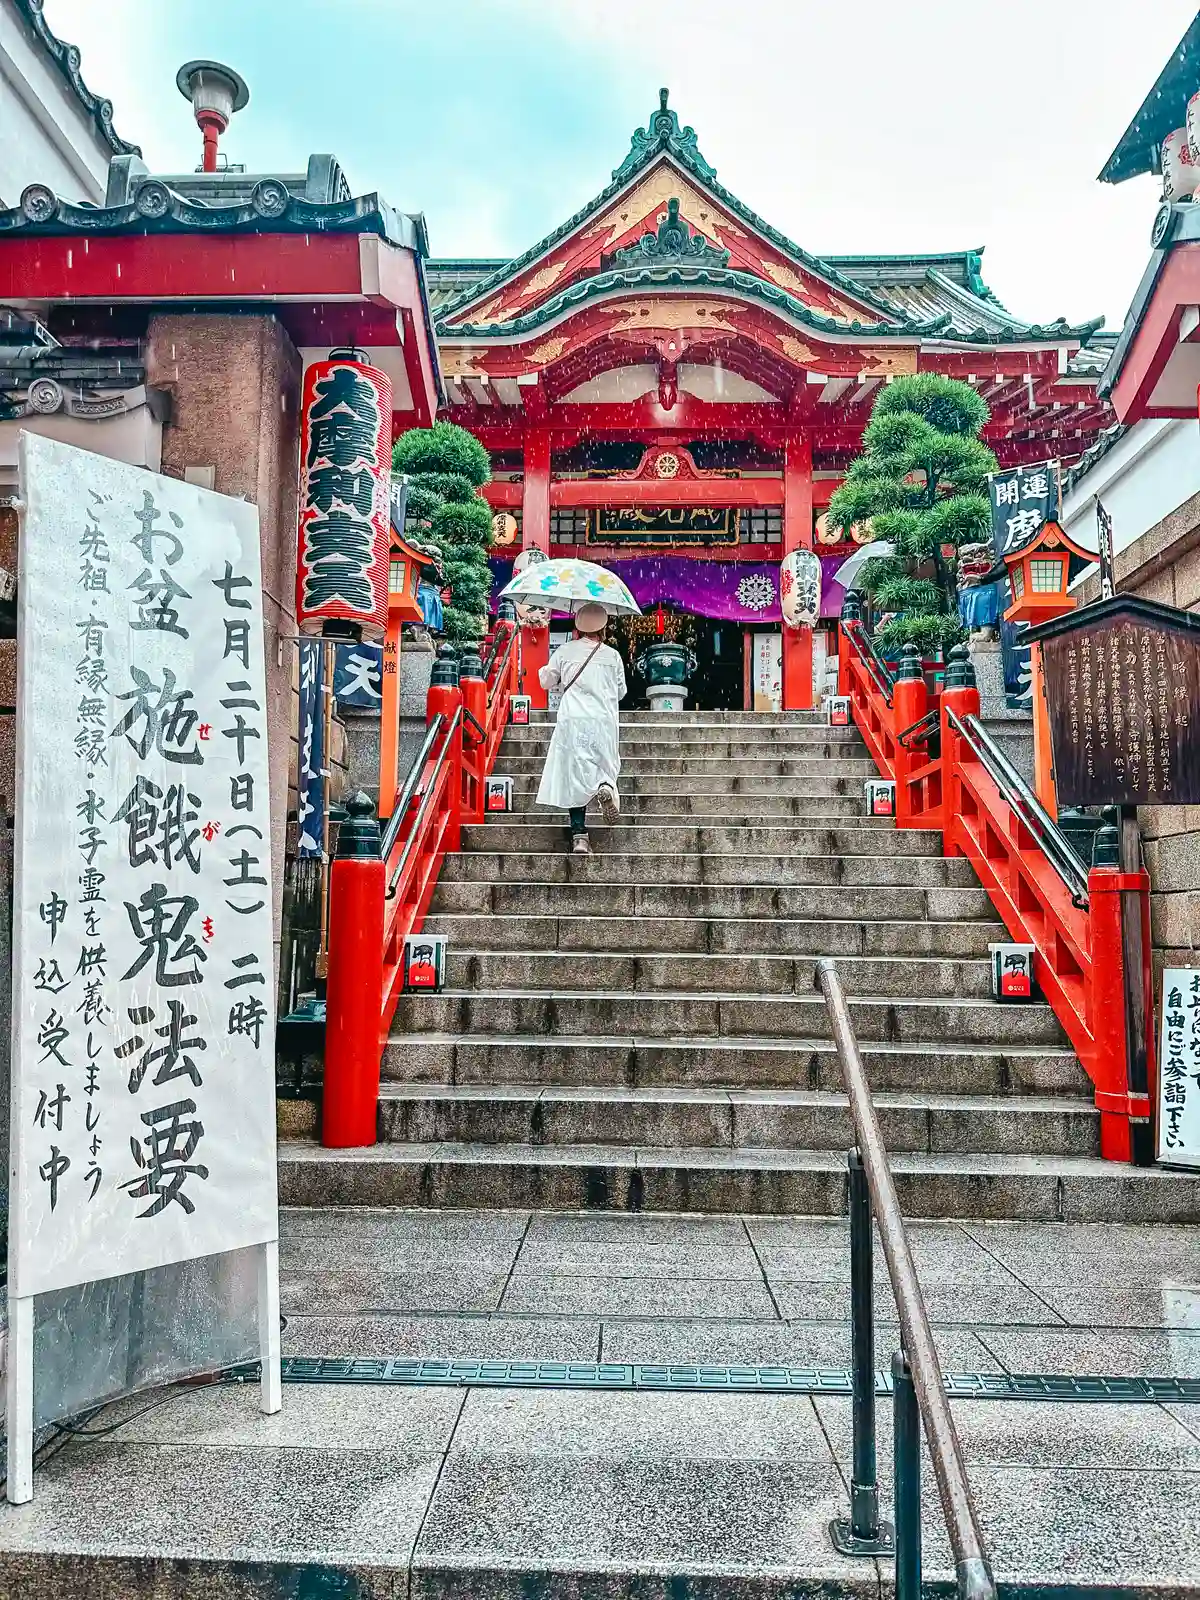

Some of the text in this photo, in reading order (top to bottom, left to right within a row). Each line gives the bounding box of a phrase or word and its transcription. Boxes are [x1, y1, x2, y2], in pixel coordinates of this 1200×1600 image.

[995, 473, 1050, 507] 開運
[383, 641, 397, 674] 献燈
[198, 723, 214, 741] せ
[202, 820, 221, 841] が
[108, 489, 209, 1218] お盆施餓鬼法要
[201, 916, 215, 944] き
[33, 890, 72, 1215] 申込受付中
[1163, 986, 1188, 1148] 自由にご参詣下さい
